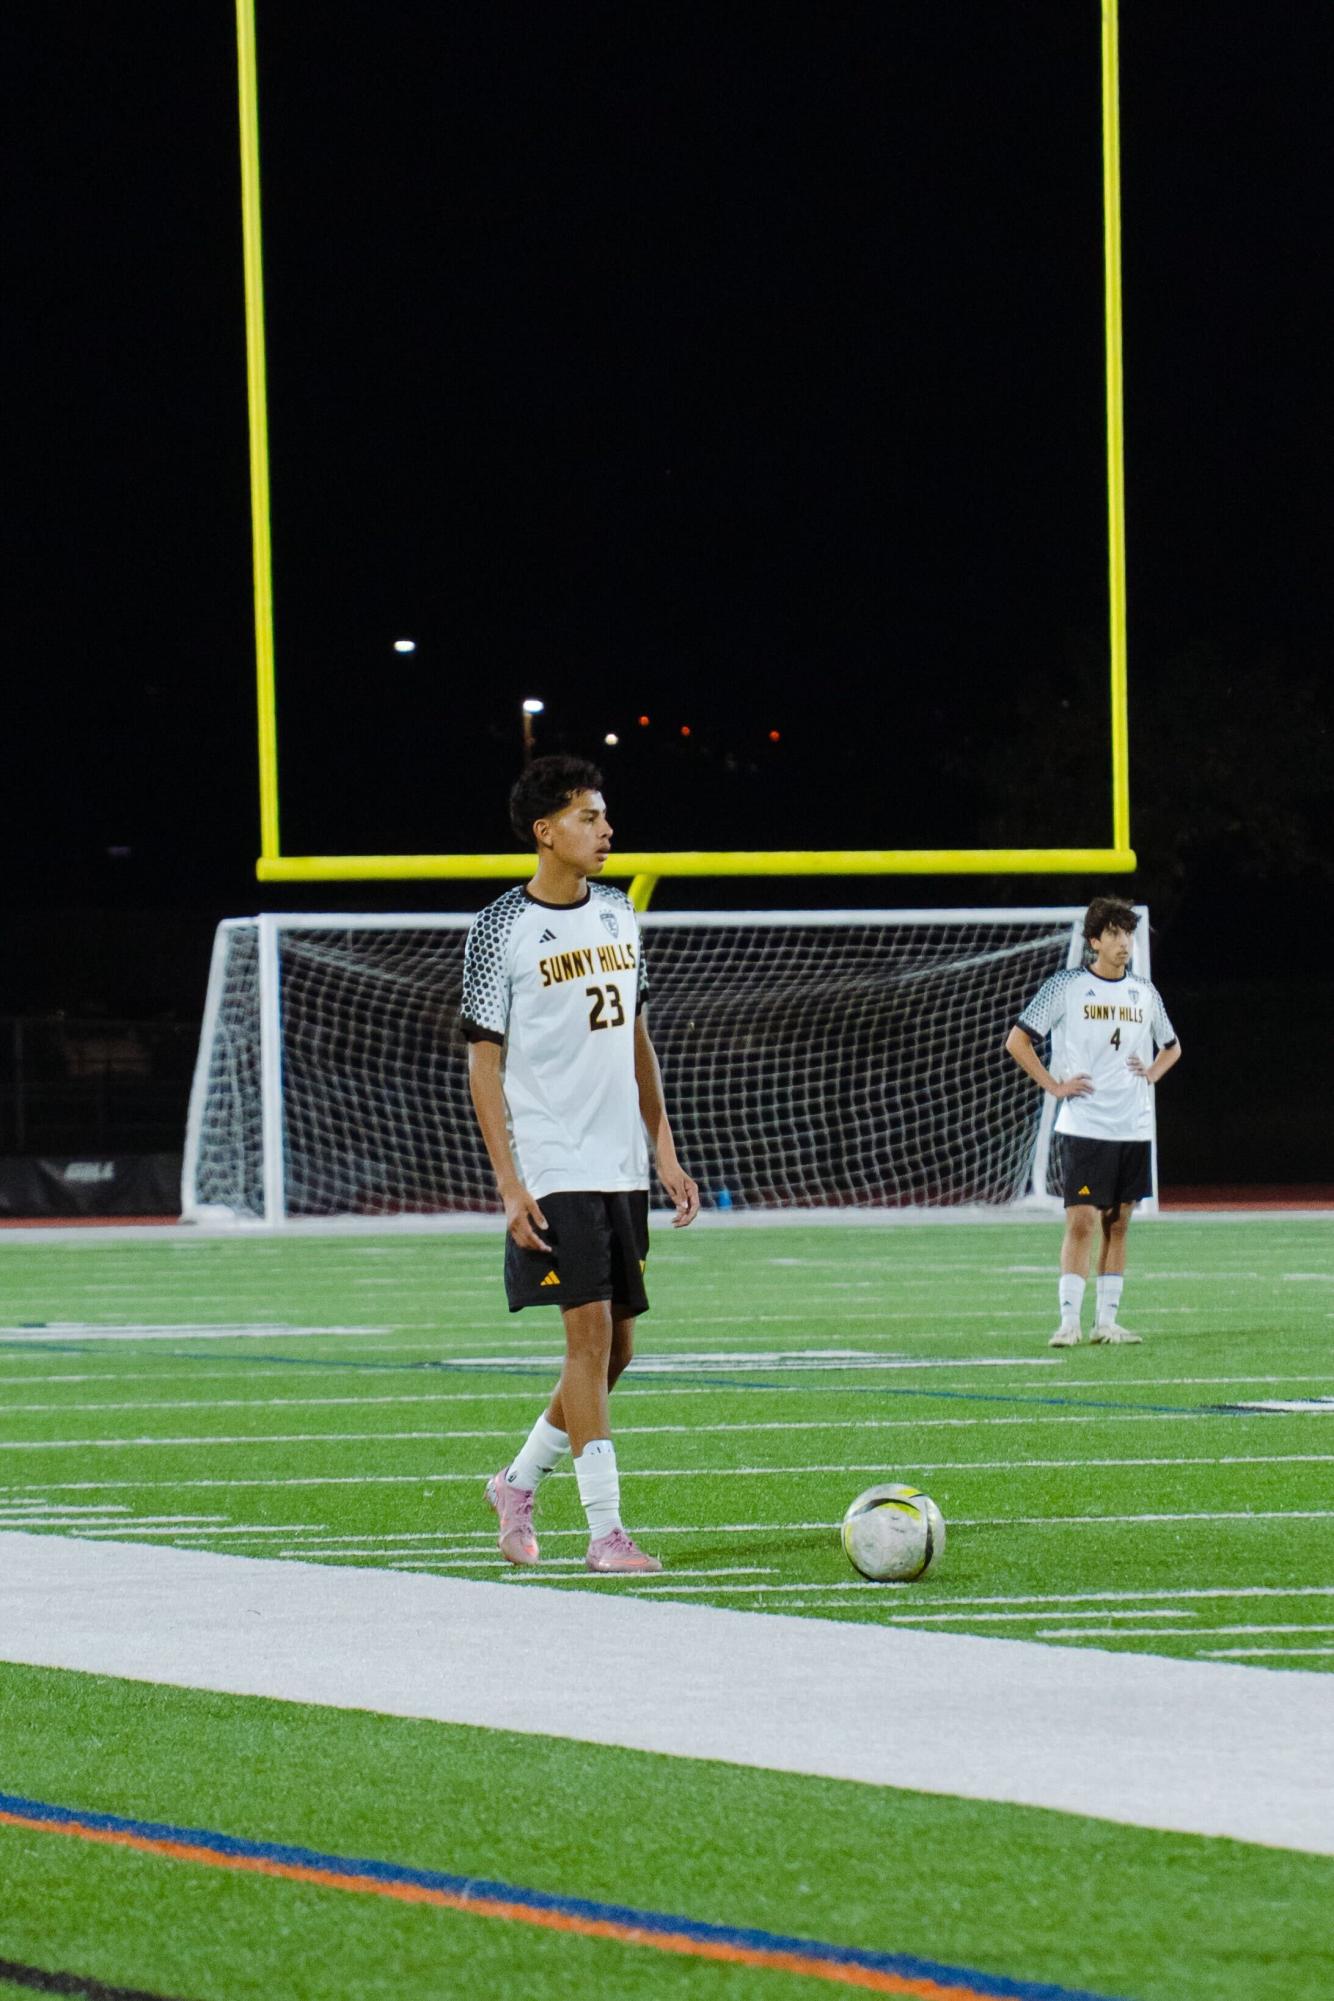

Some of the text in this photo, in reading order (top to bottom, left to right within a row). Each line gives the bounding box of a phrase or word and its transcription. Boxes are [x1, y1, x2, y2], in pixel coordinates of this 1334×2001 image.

[539, 943, 636, 987] SUNNY HILLS
[585, 983, 625, 1032] 23
[1083, 1005, 1144, 1024] SUNNY HILLS
[1109, 1027, 1121, 1052] 4
